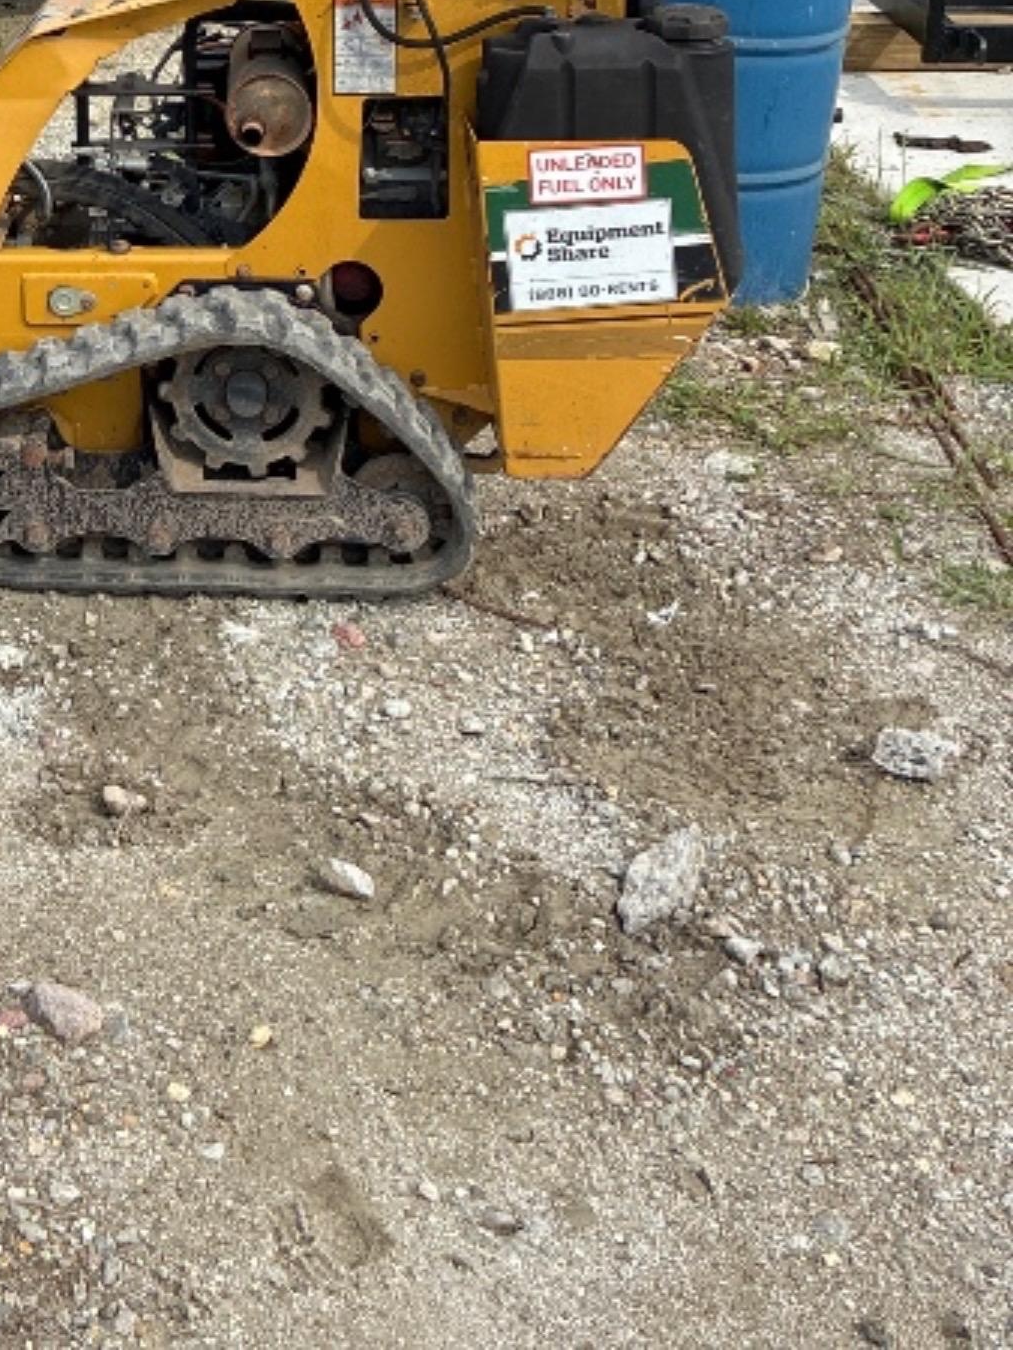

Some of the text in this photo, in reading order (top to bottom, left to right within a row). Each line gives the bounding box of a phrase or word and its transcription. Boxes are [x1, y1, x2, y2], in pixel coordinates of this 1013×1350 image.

[539, 175, 636, 195] FUEL ONLY
[546, 221, 666, 246] Equipment
[547, 246, 610, 263] Share
